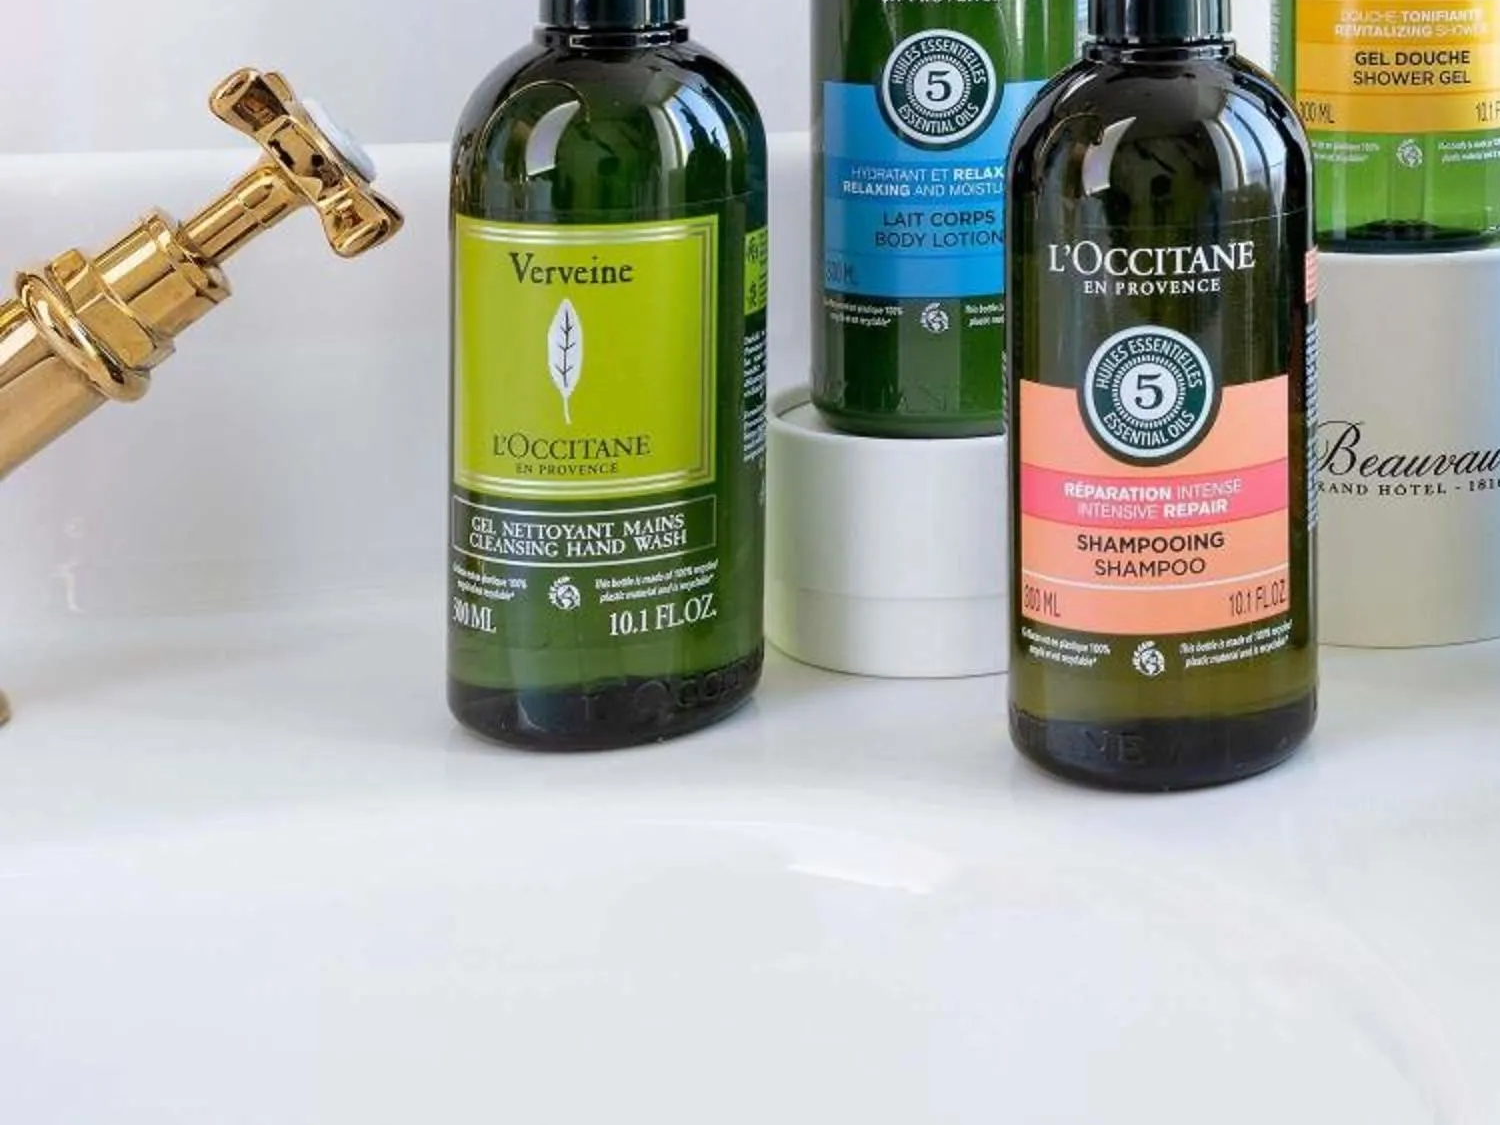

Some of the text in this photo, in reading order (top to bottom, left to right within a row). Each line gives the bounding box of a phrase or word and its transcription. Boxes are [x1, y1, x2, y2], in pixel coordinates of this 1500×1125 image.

[890, 38, 988, 85] HUILES ESSENTIELLES
[1355, 50, 1470, 66] GEL DOUCHE
[926, 71, 952, 102] 5
[1353, 70, 1472, 86] SHOWER GEL
[898, 102, 980, 135] ESSENTIAL OILS
[851, 166, 1004, 181] HYDRATANT ET RELAX
[843, 180, 1004, 196] RELAXING AND MOISTU
[883, 210, 995, 226] LAIT CORPS
[875, 230, 1004, 248] BODY LOTION
[508, 252, 633, 285] Verveine
[1049, 239, 1255, 276] L'OCCITANE
[1084, 278, 1221, 296] EN PROVENCE
[1095, 337, 1203, 390] HUILES ESSENTIELLES
[1135, 374, 1162, 410] 5
[1103, 410, 1196, 446] ESSENTIAL OILS
[494, 432, 652, 460] L'OCCITANE
[516, 462, 618, 476] EN PROVENCE
[1064, 479, 1241, 500] RÉPARATION INTENSE
[1317, 482, 1368, 496] RAND
[1378, 482, 1447, 497] HÔTEL
[1078, 499, 1229, 521] INTENSIVE REPAIR
[471, 513, 685, 540] GEL NETTOYANT MAINS
[470, 529, 687, 557] CLEANSING HAND WASH
[1077, 532, 1225, 554] SHAMPOOING
[1095, 557, 1206, 578] SHAMPOO
[1023, 584, 1061, 618] 300 ML
[1229, 594, 1251, 618] 10.1
[471, 604, 497, 633] ML
[609, 608, 648, 635] 10.1
